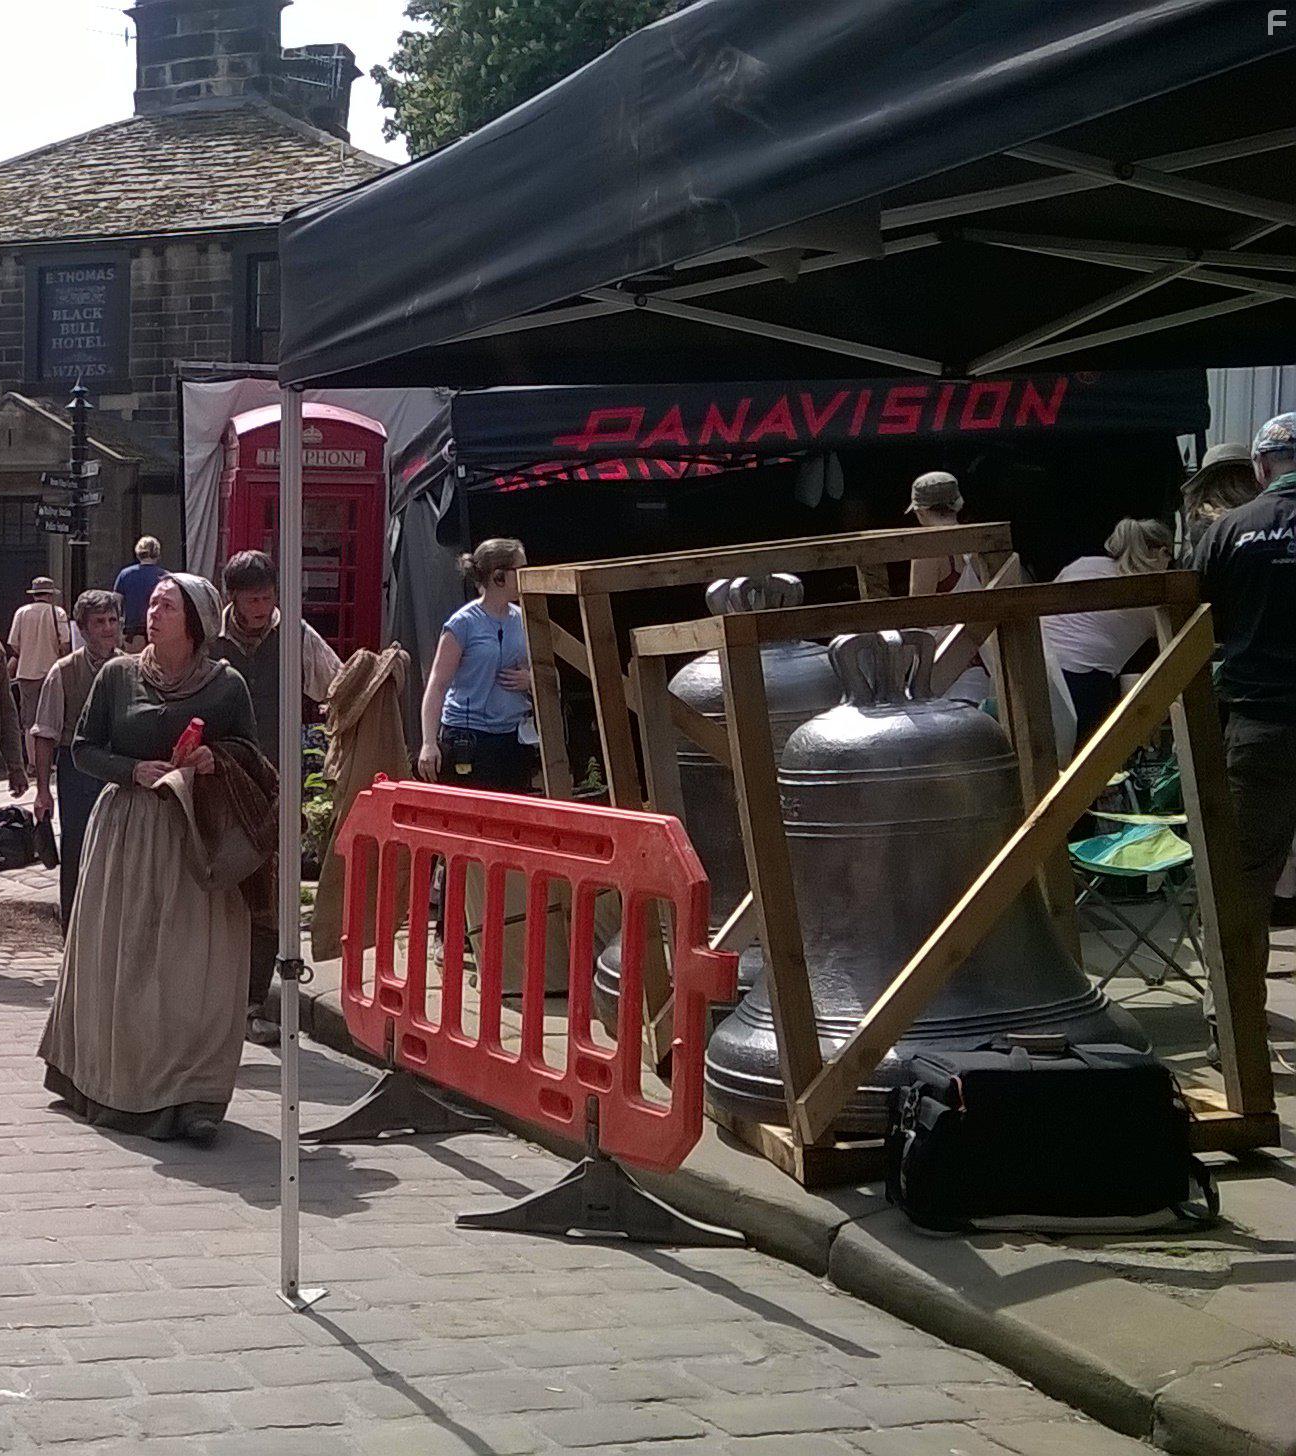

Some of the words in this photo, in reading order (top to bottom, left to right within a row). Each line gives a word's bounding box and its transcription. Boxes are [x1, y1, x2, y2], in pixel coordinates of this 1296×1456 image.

[52, 307, 103, 320] BLACK
[60, 322, 99, 335] BULL
[52, 336, 106, 349] HOTEL
